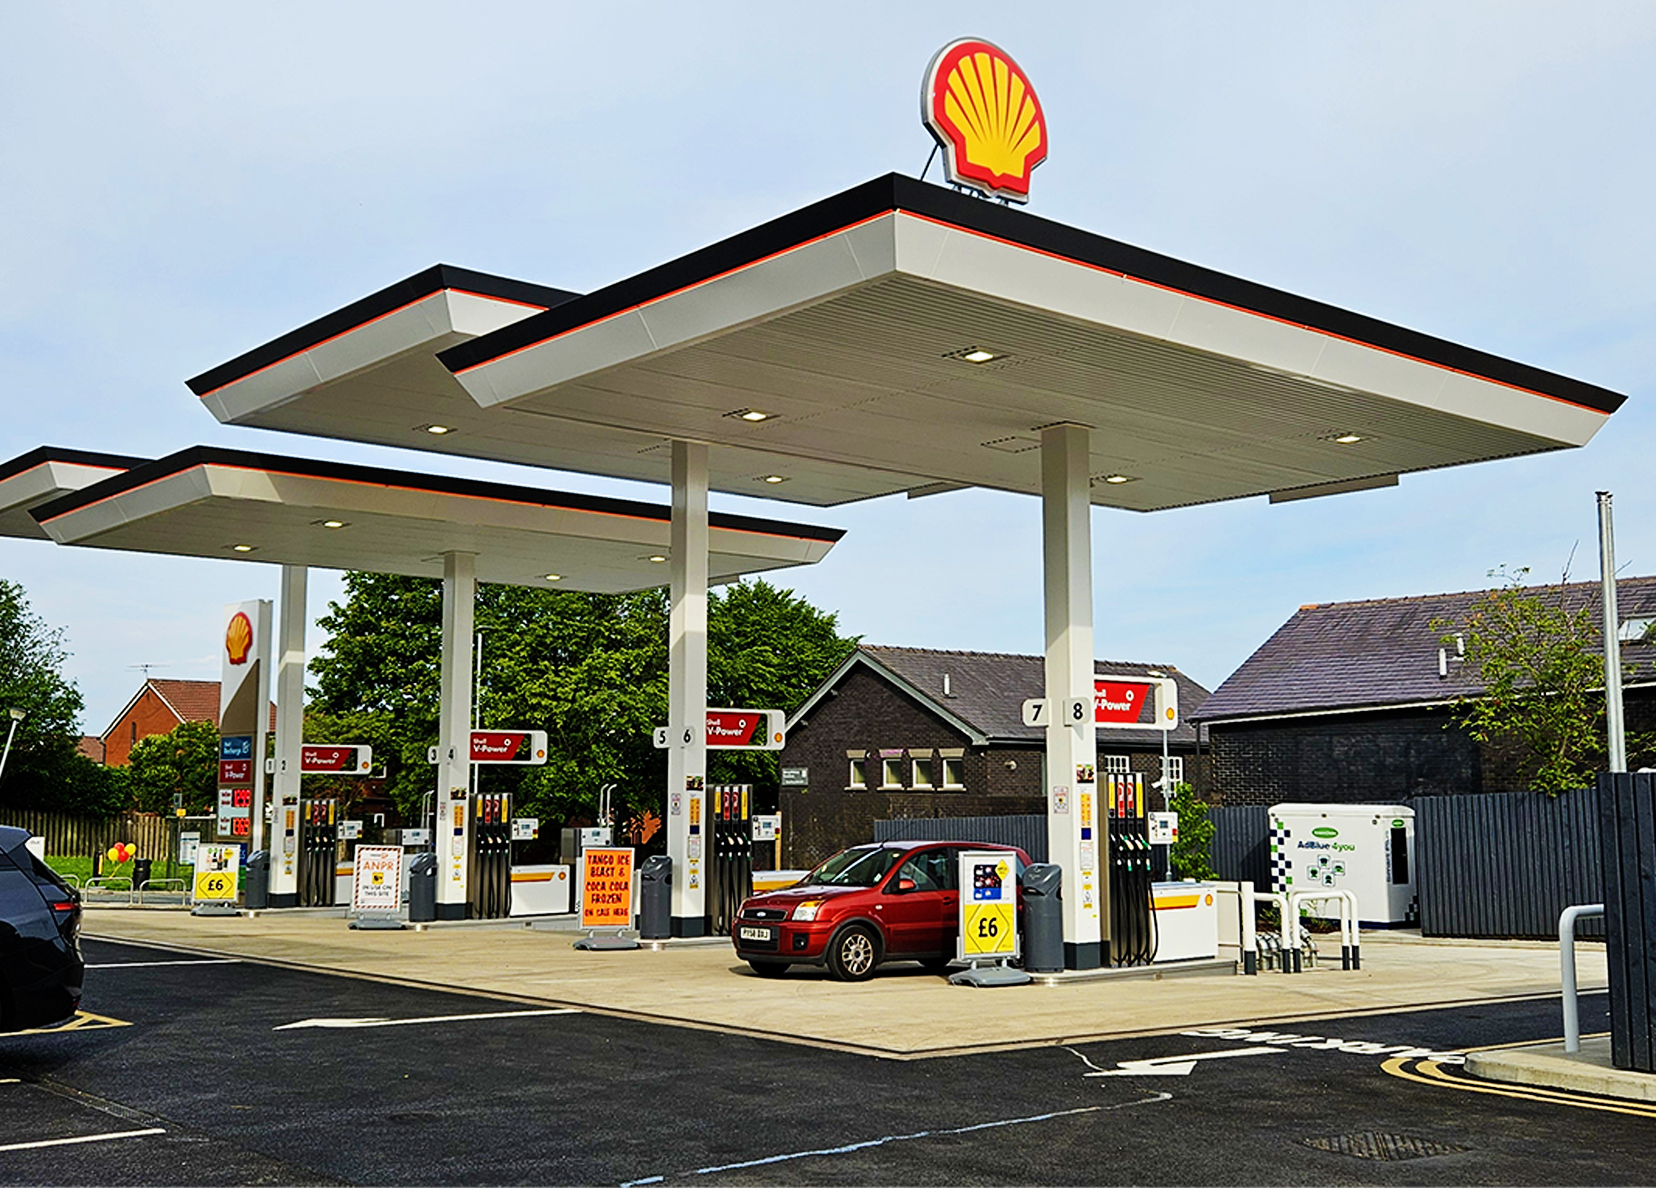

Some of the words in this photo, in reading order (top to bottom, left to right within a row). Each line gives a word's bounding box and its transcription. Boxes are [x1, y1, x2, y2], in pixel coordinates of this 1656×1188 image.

[1032, 704, 1042, 721] 7
[1073, 702, 1083, 720] 8
[659, 730, 666, 744] 5
[683, 729, 691, 743] 6
[706, 727, 743, 736] V-Power
[432, 748, 437, 761] 3
[448, 748, 454, 759] 4
[473, 745, 508, 753] V-Power
[281, 760, 286, 771] 2
[1297, 841, 1330, 850] AdBlue
[1332, 842, 1355, 852] 4you
[587, 855, 614, 865] TANGO
[617, 854, 630, 865] ICE
[363, 861, 394, 870] ANPR
[590, 866, 615, 877] BLAST
[618, 867, 625, 877] &
[207, 879, 224, 891] £6
[586, 881, 606, 891] COCA
[609, 881, 629, 891] COLA
[591, 893, 622, 904] FROZEN
[584, 908, 594, 917] ON
[596, 908, 610, 917] SALE
[613, 908, 629, 917] HERE
[978, 917, 998, 938] £6
